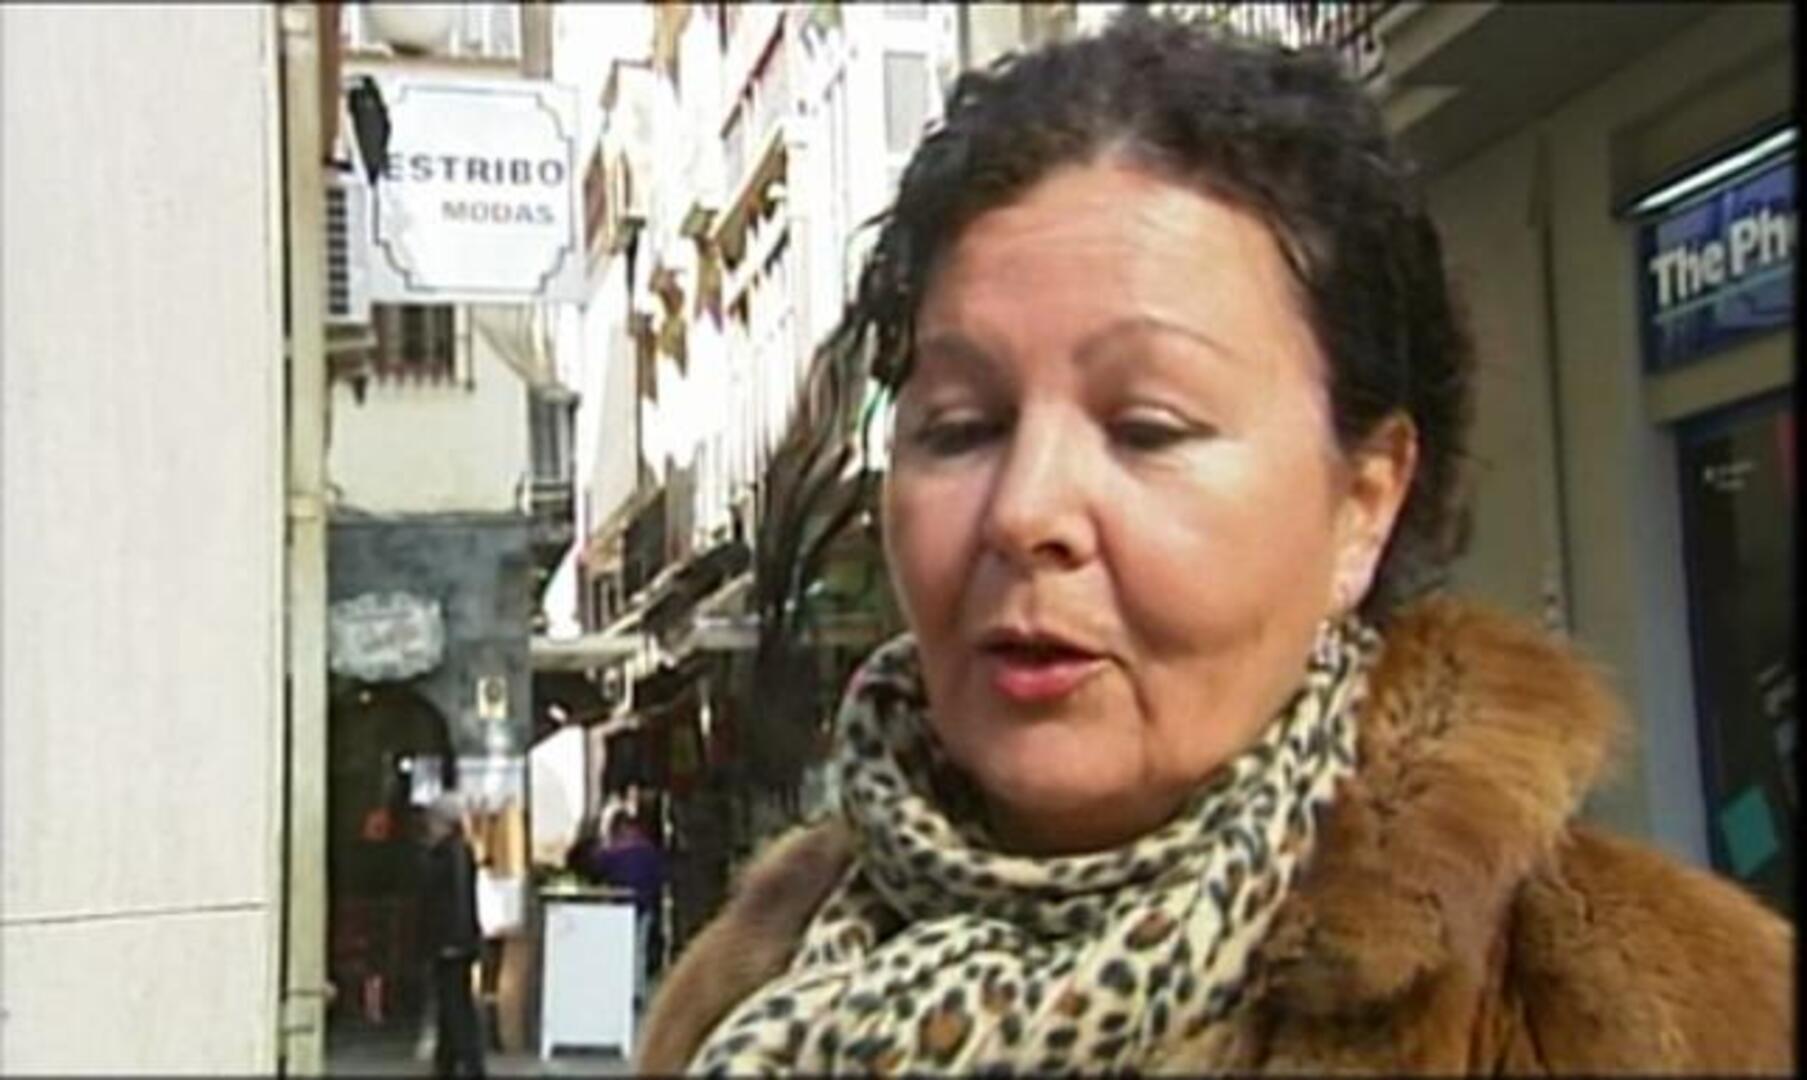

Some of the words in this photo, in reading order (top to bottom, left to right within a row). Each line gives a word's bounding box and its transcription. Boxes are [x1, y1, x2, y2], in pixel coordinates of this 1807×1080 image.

[382, 152, 566, 186] ESTRIBO
[441, 199, 556, 225] MODAS
[1649, 242, 1726, 307] The
[1729, 207, 1798, 276] Ph
